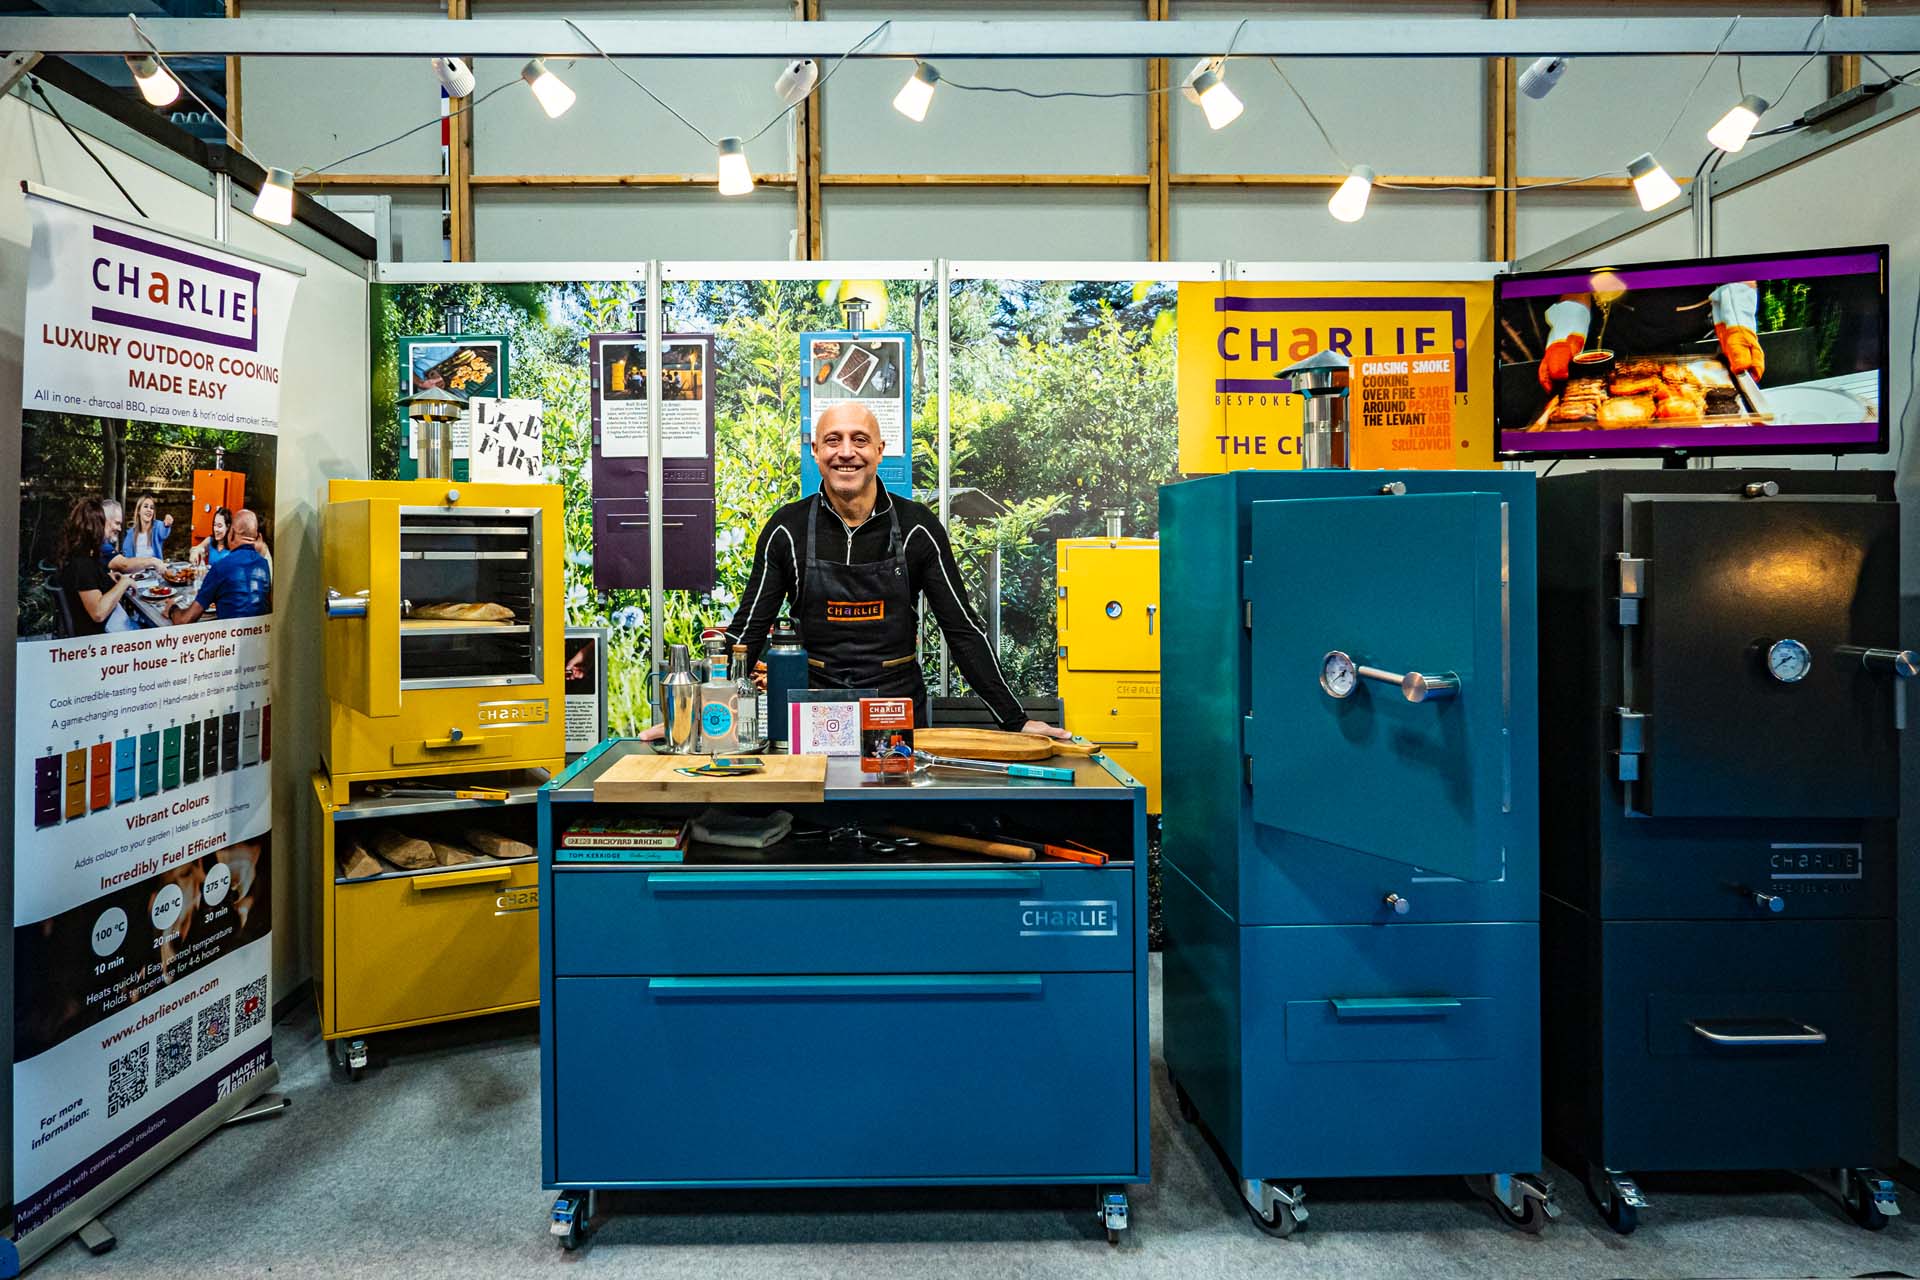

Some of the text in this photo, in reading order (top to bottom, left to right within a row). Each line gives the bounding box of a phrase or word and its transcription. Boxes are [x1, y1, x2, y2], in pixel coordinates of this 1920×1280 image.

[43, 323, 279, 384] LUXURY OUTDOOR COOKING
[1362, 361, 1409, 375] CHASING
[1412, 359, 1451, 374] SMOKE
[129, 369, 227, 401] MADE EASY
[1362, 375, 1409, 388] COOKING
[1362, 387, 1416, 400] OVER FIRE
[34, 389, 49, 401] All
[52, 391, 62, 403] in
[64, 395, 81, 405] one
[89, 396, 124, 411] charcoal
[126, 400, 148, 415] BBQ,
[150, 404, 170, 418] pizza
[171, 408, 191, 418] oven
[1216, 395, 1291, 406] BESPOKE
[1363, 400, 1406, 413] AROUND
[478, 402, 544, 442] LIVE
[1363, 413, 1426, 427] THE LEVANT
[478, 432, 543, 477] FIRE
[1216, 436, 1267, 455] THE
[49, 643, 97, 664] There's
[100, 646, 107, 656] a
[111, 640, 152, 655] reason
[155, 632, 179, 650] why
[182, 630, 227, 647] everyone
[230, 626, 262, 639] comes
[100, 663, 129, 681] your
[133, 655, 168, 672] house
[180, 649, 195, 665] it's
[198, 644, 236, 661] Charlie!
[49, 697, 72, 709] Cook
[74, 686, 137, 704] incredible-tasting
[138, 681, 156, 693] food
[157, 680, 172, 688] with
[173, 677, 187, 686] ease
[51, 720, 58, 729] A
[61, 709, 119, 730] game-changing
[120, 700, 158, 714] innovation
[126, 793, 210, 831] Vibrant Colours
[74, 857, 94, 871] Adds
[95, 846, 119, 862] colour
[120, 844, 129, 854] to
[130, 837, 146, 852] your
[146, 829, 171, 847] garden
[191, 818, 201, 829] for
[100, 831, 227, 891] Incredibly Fuel Efficient
[205, 878, 219, 894] 375
[496, 892, 538, 909] CHaR
[154, 901, 170, 917] 240
[204, 906, 229, 924] 30 min
[95, 927, 112, 943] 100
[153, 930, 180, 950] 20 min
[86, 926, 233, 1006] Heats quickly Easy control temperature
[94, 955, 125, 977] 10 min
[103, 993, 128, 1012] Holds
[177, 962, 188, 974] for
[188, 955, 200, 967] 4-6
[201, 945, 220, 960] hours
[100, 976, 220, 1050] www.charlieoven.com
[231, 1051, 266, 1082] MADE IN
[231, 1061, 265, 1091] BRITAIN
[39, 1097, 83, 1130] For more
[31, 1108, 90, 1151] information:
[17, 1202, 42, 1224] Made
